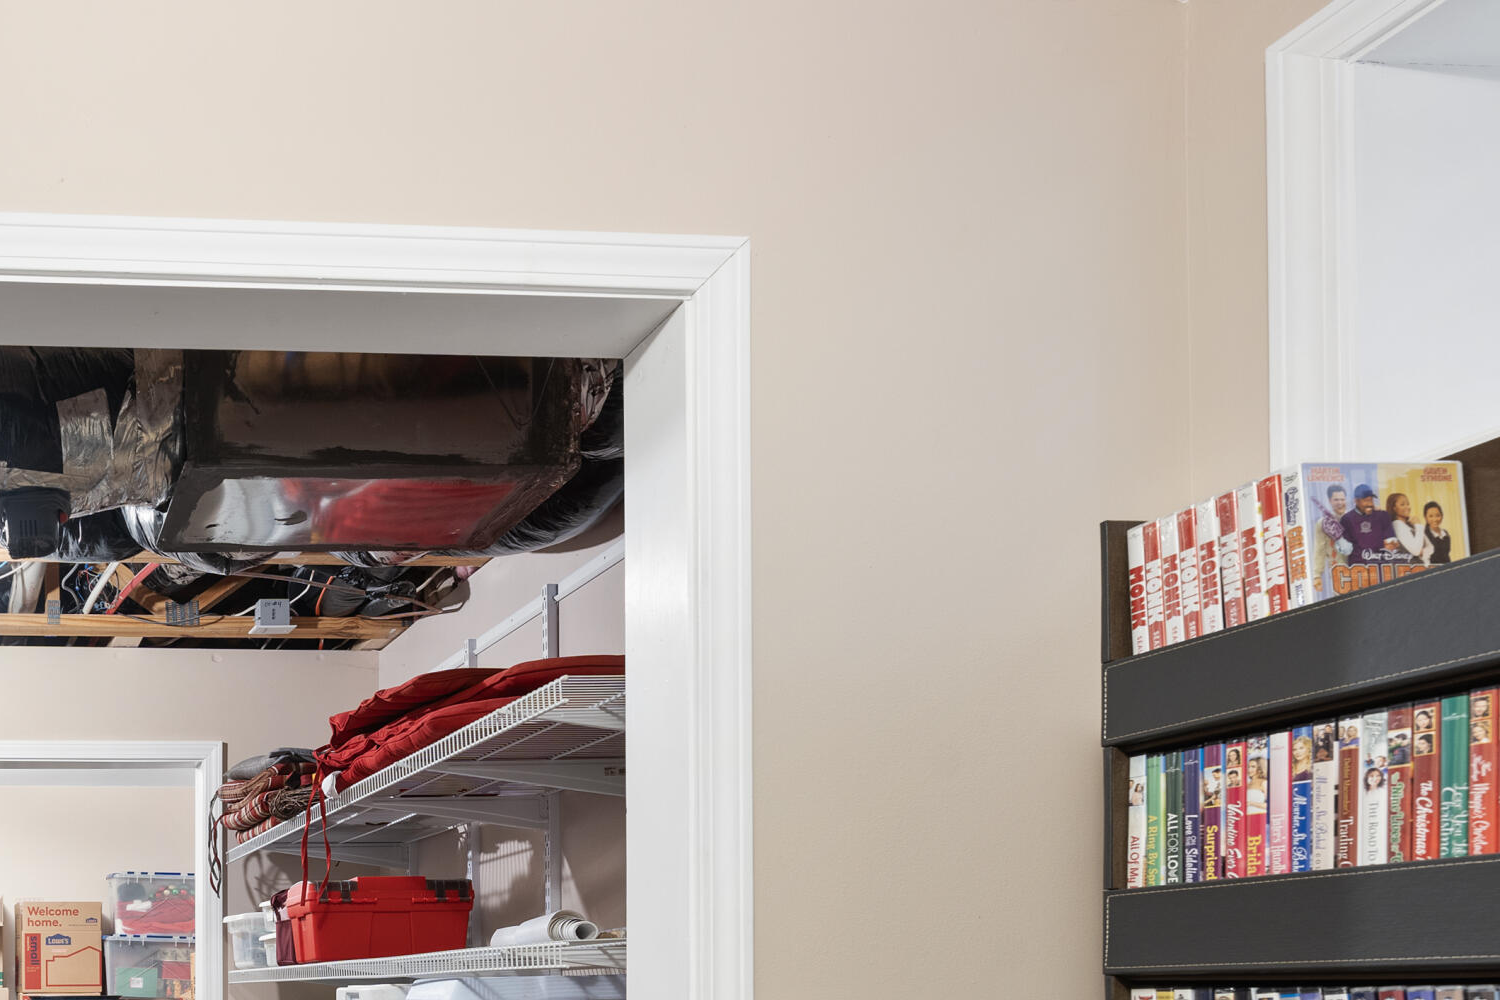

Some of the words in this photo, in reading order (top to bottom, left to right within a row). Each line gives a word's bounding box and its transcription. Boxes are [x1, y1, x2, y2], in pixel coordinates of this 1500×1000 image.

[1220, 531, 1242, 602] MONK
[1241, 526, 1261, 598] MONK
[1263, 516, 1285, 591] MONK
[1163, 553, 1180, 620] MONK
[1180, 547, 1200, 615] MONK
[1200, 540, 1218, 609] MONK
[1130, 566, 1146, 630] MONK
[1146, 559, 1164, 625] MONK
[1419, 780, 1433, 796] The
[1148, 815, 1158, 823] A
[1167, 813, 1179, 832] ALL
[1185, 814, 1199, 835] Love
[1226, 800, 1244, 847] Valentine
[1415, 796, 1434, 857] Christmas
[1131, 835, 1141, 851] All
[1147, 826, 1159, 849] Ring
[1167, 833, 1179, 854] FOR
[1338, 816, 1354, 860] Trading
[1367, 821, 1379, 848] ROAD
[1205, 825, 1219, 881] Surprised
[1226, 848, 1243, 869] Ever
[1167, 855, 1179, 884] LOVE
[27, 906, 79, 917] Welcome
[27, 917, 62, 927] home.
[31, 936, 40, 966] small
[47, 937, 69, 945] LOWE'S
